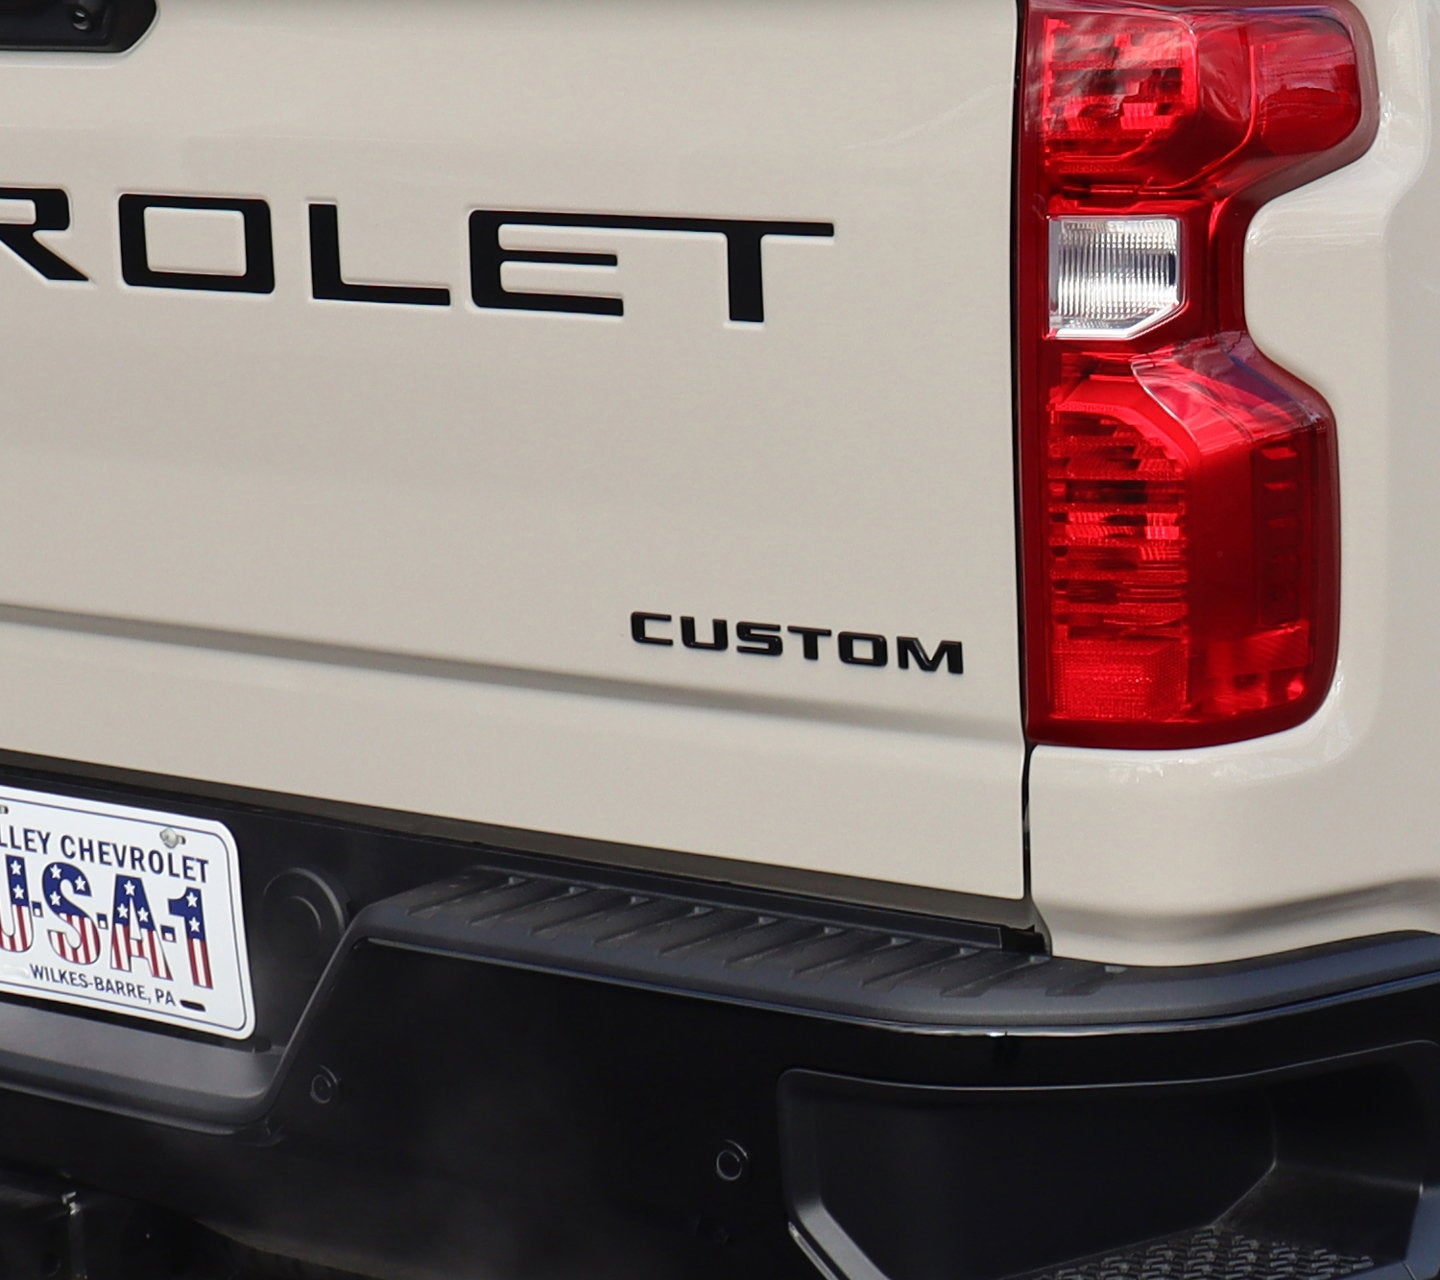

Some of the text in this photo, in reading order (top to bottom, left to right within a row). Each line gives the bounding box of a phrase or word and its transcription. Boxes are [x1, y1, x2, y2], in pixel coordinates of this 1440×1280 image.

[630, 610, 964, 675] CUSTOM
[60, 834, 210, 883] CHEVROLET
[29, 963, 177, 1008] WILKES-BARRE, PA
